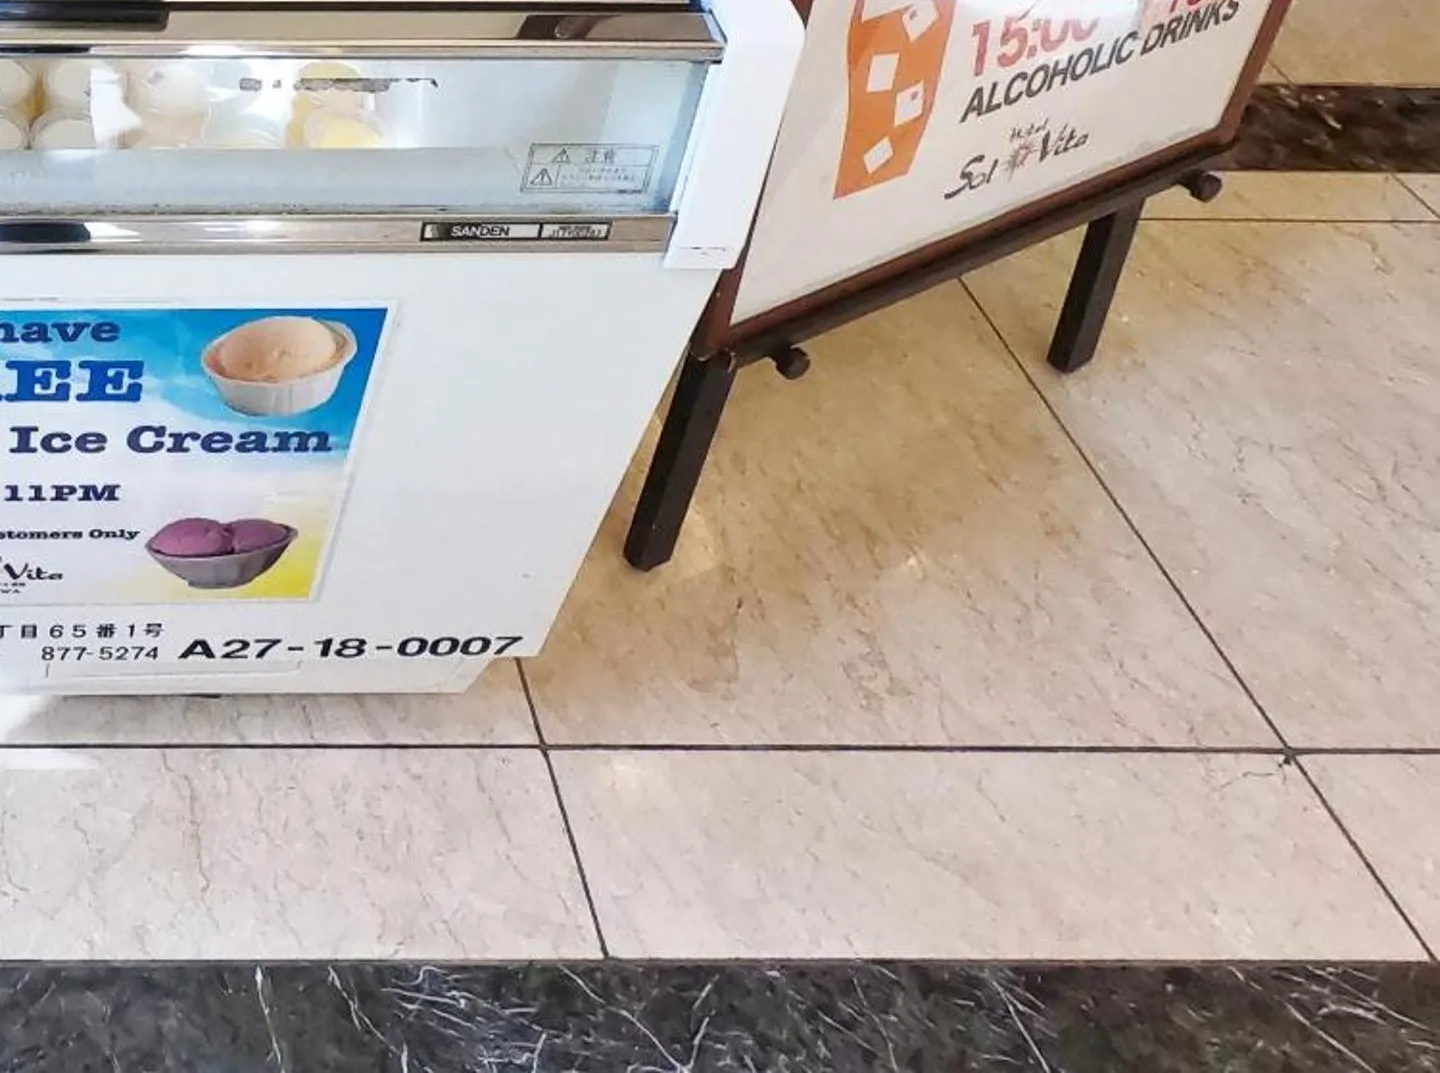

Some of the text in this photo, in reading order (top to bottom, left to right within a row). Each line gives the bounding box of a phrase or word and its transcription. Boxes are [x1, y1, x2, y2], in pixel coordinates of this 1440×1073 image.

[960, 29, 1140, 123] ALCOHOLIC
[450, 225, 510, 237] SANDEN
[8, 425, 107, 455] Ice
[126, 424, 334, 455] Cream
[4, 484, 121, 502] 11PM
[89, 528, 140, 541] Only
[4, 562, 63, 581] Vita
[41, 646, 160, 661] 877-5274
[178, 635, 523, 660] A27-18-0007
